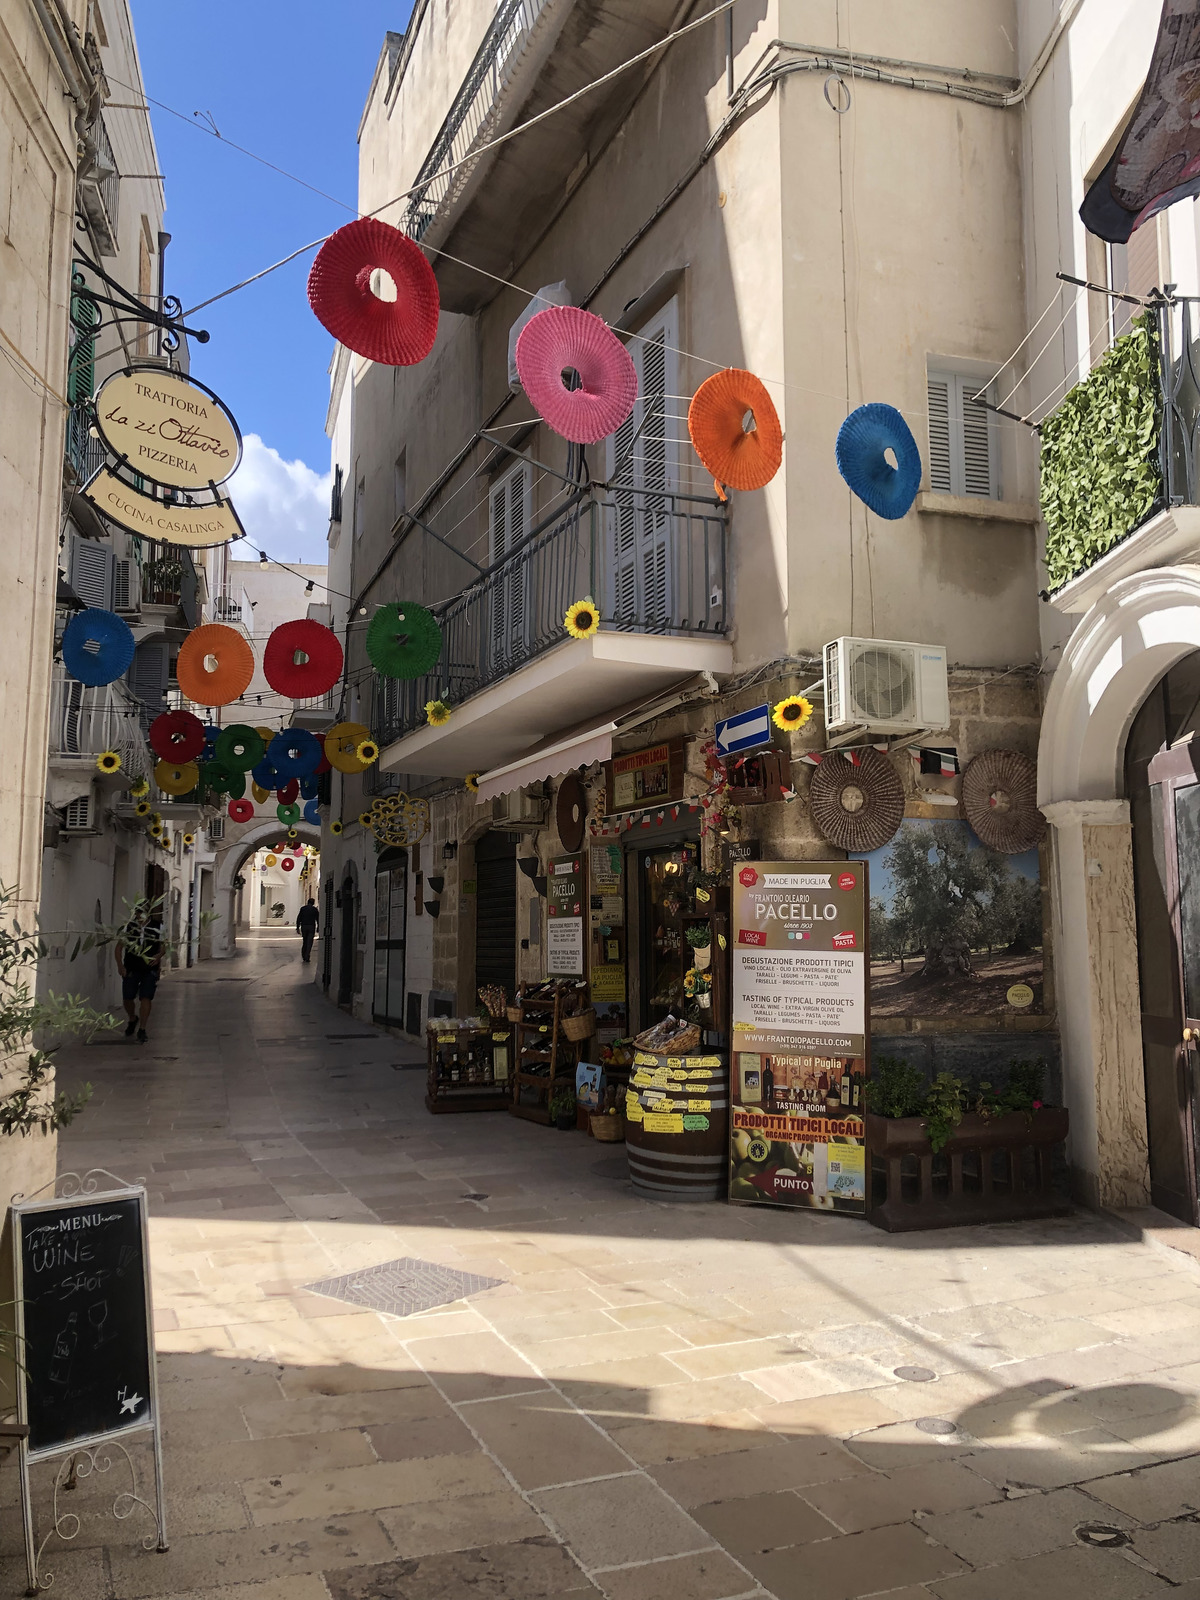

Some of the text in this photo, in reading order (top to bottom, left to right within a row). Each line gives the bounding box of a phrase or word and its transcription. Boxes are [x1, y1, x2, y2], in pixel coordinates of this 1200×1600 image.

[135, 383, 208, 419] TRATTORIA
[134, 420, 156, 434] zi
[159, 418, 229, 458] Ottavio
[138, 445, 198, 474] PIZZERIA
[108, 493, 224, 533] CUCINA CASALINGA
[650, 747, 668, 763] LOCALI
[552, 883, 575, 897] PACELLO
[755, 894, 783, 902] FRANTOIO
[785, 894, 810, 903] OLEARIO
[755, 904, 837, 920] PACELLO
[835, 939, 854, 947] PASTA
[742, 957, 793, 965] DEGUSTAZIONE
[796, 958, 831, 966] PRODOTTI
[742, 994, 770, 1003] TASTING
[785, 996, 813, 1005] TYPICAL
[816, 998, 854, 1006] PRODUCTS
[744, 1034, 851, 1046] WWW.FRANTOIOPACELLO.COM
[772, 1055, 801, 1066] Typical
[804, 1058, 811, 1066] of
[814, 1058, 842, 1070] Puglia
[776, 1101, 826, 1112] TASTING ROOM
[734, 1113, 863, 1136] PRODOTTI TIPICI LOCALI
[766, 1131, 826, 1143] ORGANIC PRODUCTS
[773, 1178, 809, 1190] PUNTO
[59, 1213, 101, 1232] MENU
